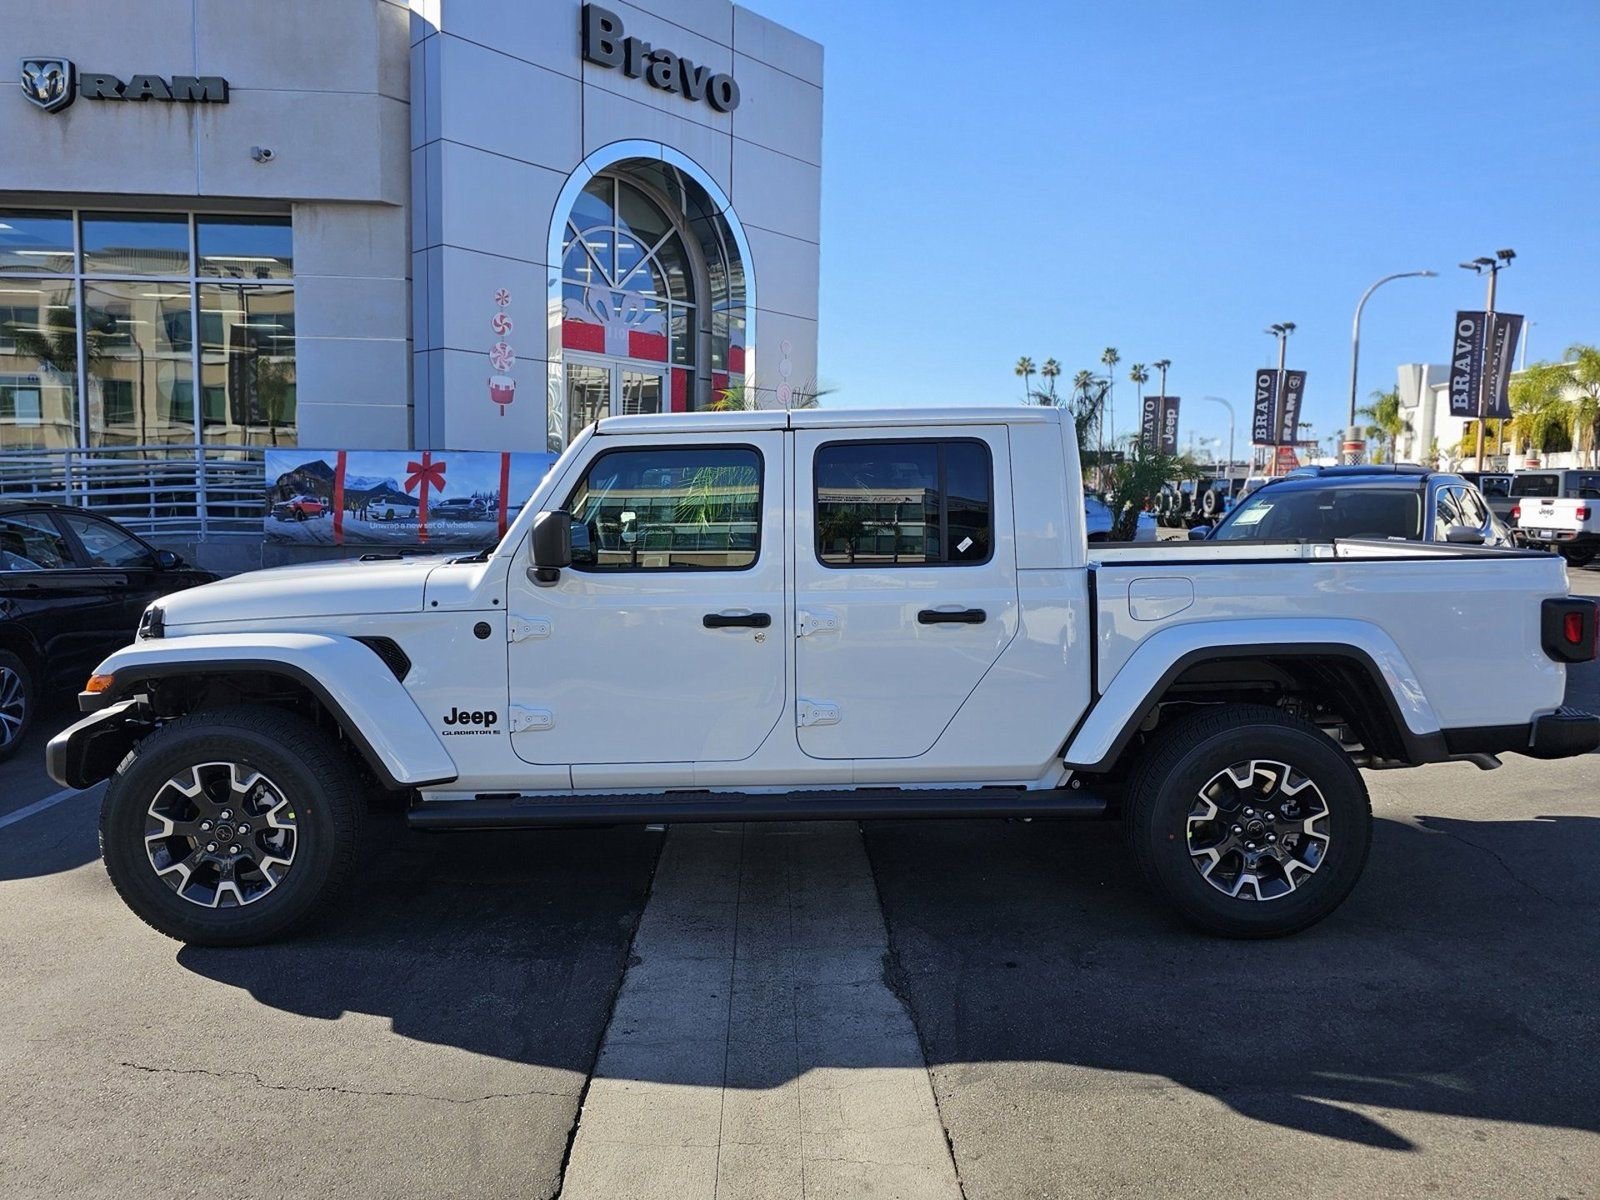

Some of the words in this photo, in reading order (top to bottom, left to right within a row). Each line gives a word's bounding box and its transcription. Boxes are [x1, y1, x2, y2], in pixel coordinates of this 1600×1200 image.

[583, 3, 740, 113] Bravo
[80, 73, 228, 103] RAM
[1452, 319, 1475, 410] BRAVO
[1255, 374, 1271, 440] BRAVO
[1283, 393, 1297, 441] RAM
[1162, 409, 1178, 444] Jeep
[1494, 465, 1507, 473] 30
[369, 522, 399, 531] Unwrap
[437, 521, 445, 529] of
[1538, 507, 1555, 516] Jeep
[443, 707, 498, 728] Jeep
